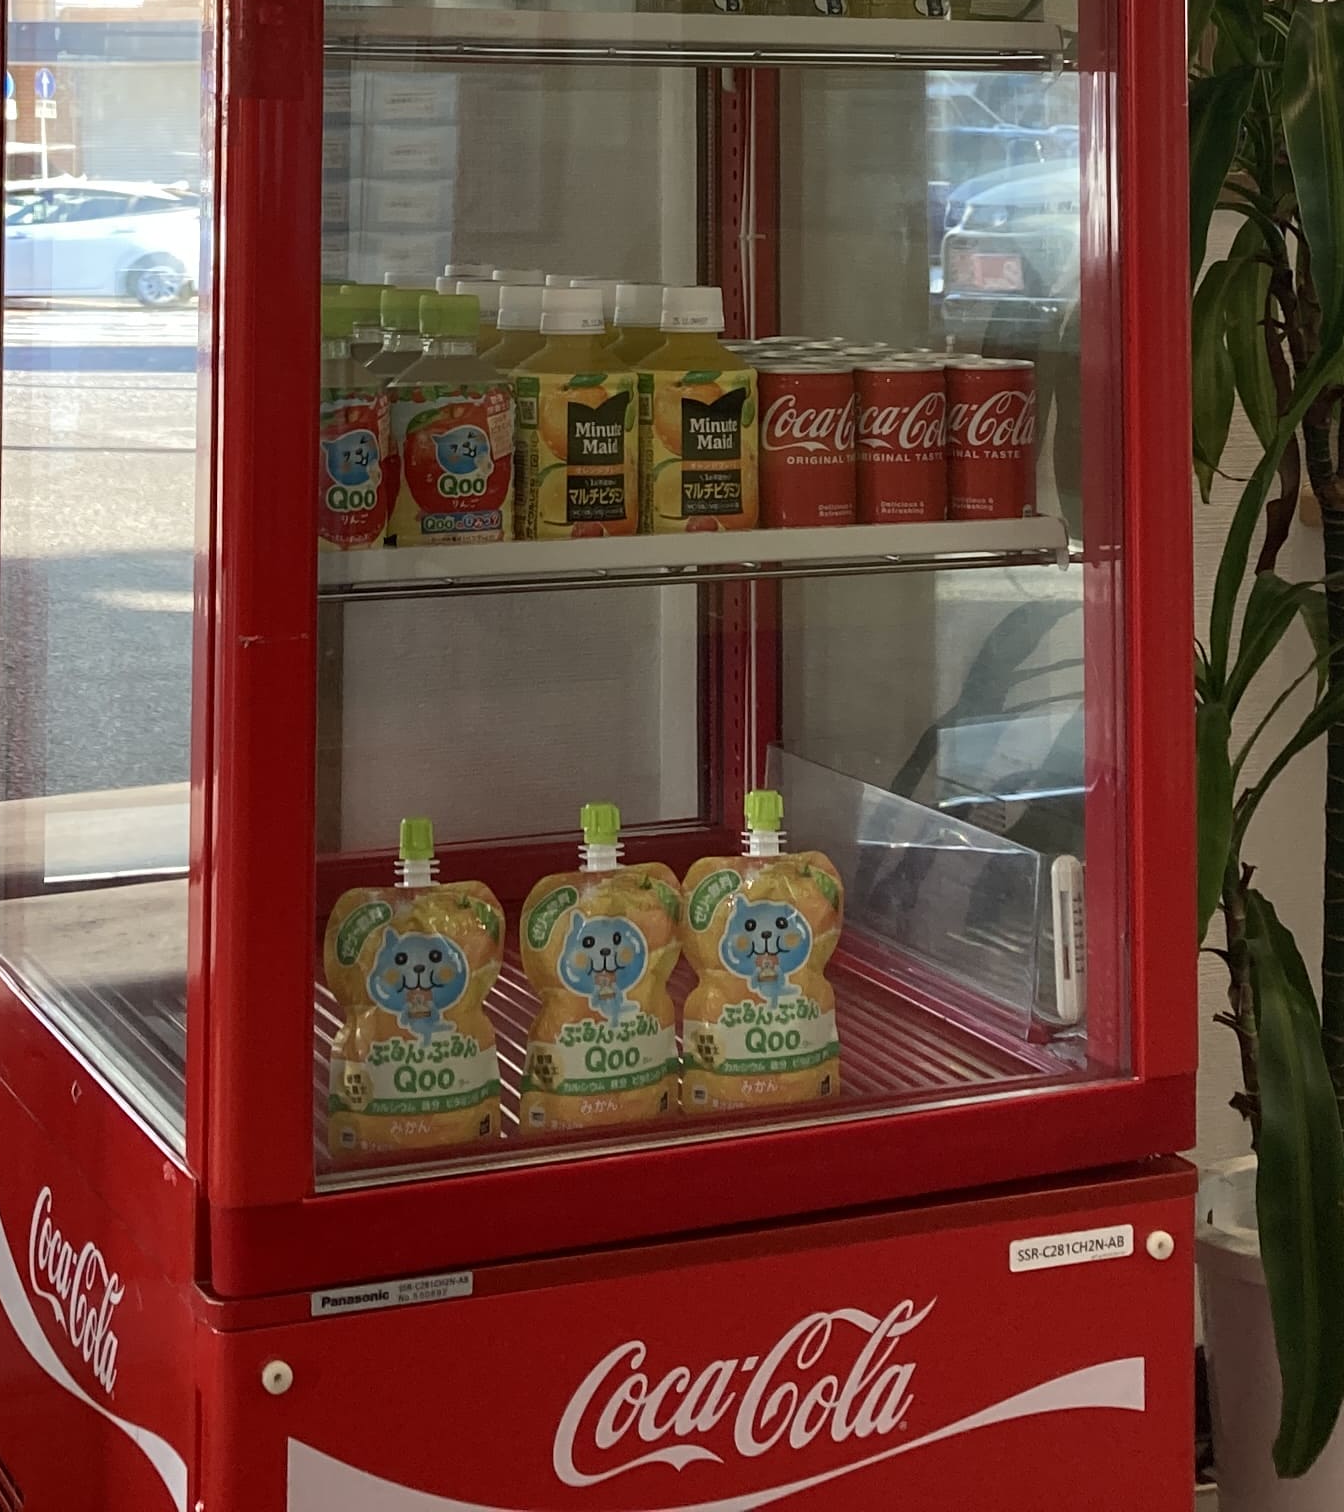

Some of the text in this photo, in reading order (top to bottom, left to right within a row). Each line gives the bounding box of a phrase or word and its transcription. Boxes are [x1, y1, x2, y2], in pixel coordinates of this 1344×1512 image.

[689, 418, 738, 434] Minute
[762, 392, 856, 452] Coca-C
[950, 390, 1036, 447] a-Cola
[575, 422, 622, 438] Minute
[582, 439, 618, 455] Maid
[697, 434, 733, 450] Maid
[786, 455, 844, 465] ORIGINAL
[984, 449, 1021, 459] TASTE
[439, 474, 485, 496] Qoo
[683, 482, 740, 499] マルチビタミン
[328, 486, 375, 510] Qoo
[745, 1027, 801, 1054] Qoo
[585, 1045, 640, 1073] Qoo
[393, 1065, 455, 1093] Qoo
[741, 1079, 778, 1094] みかん
[580, 1100, 618, 1113] みかん
[390, 1121, 431, 1135] みかん
[1017, 1235, 1125, 1262] SSR-C281CH2N-AB
[29, 1184, 125, 1402] Coca-Cola
[321, 1290, 390, 1308] Panasonic
[552, 1296, 939, 1487] Coca-Cola
